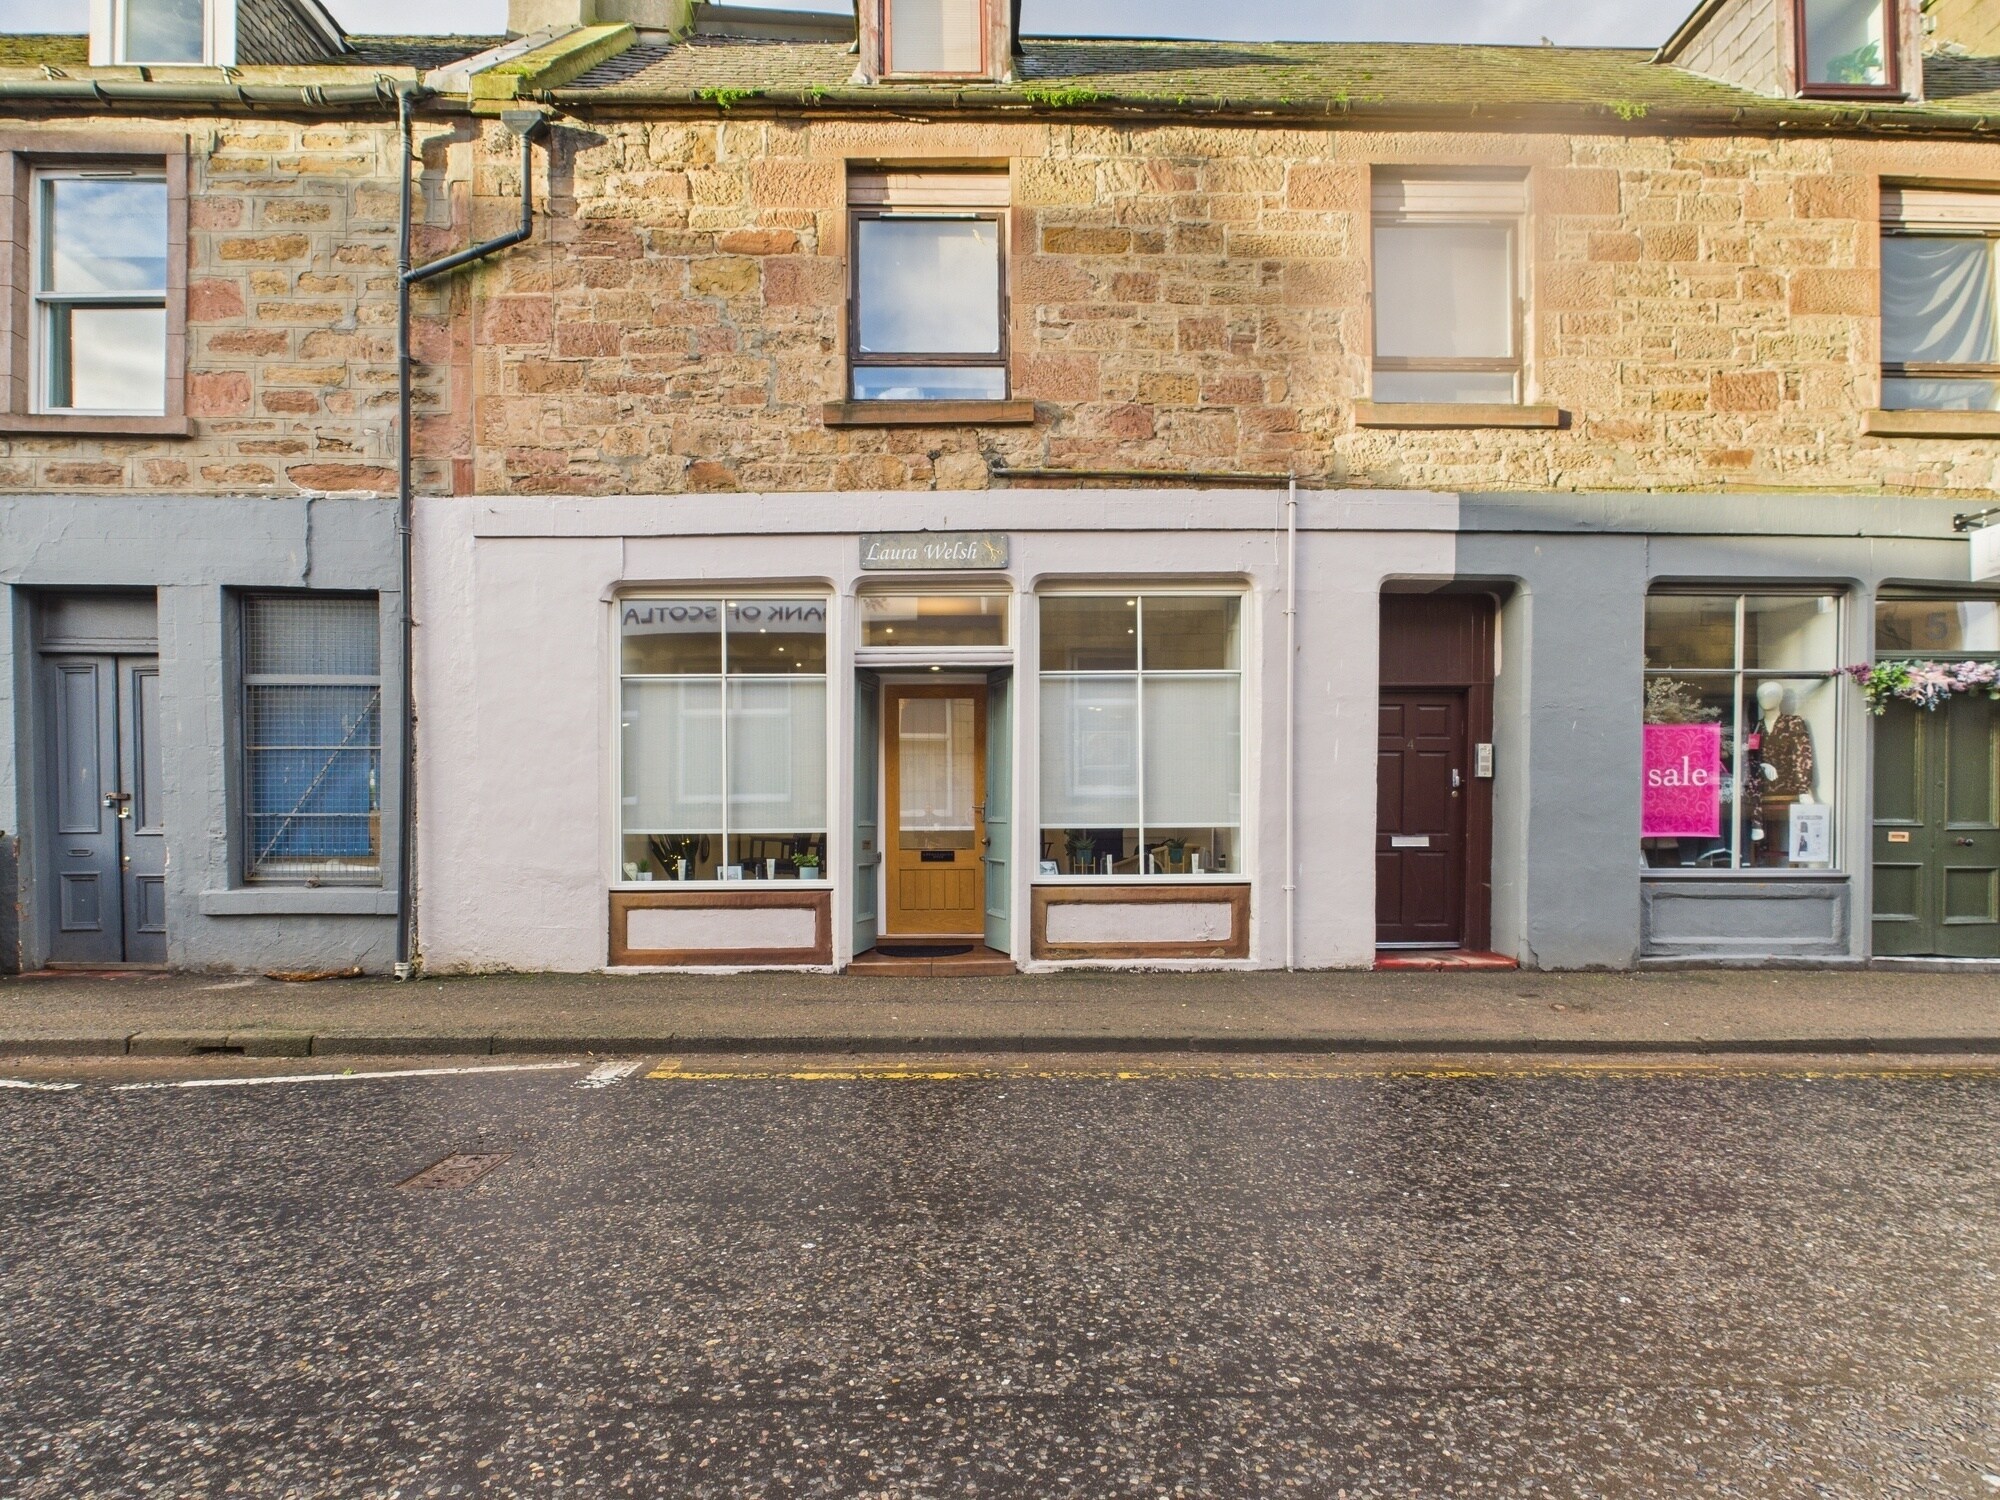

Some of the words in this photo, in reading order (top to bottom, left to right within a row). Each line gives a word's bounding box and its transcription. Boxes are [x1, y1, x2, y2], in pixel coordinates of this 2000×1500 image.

[865, 542, 918, 561] Laura
[923, 541, 977, 560] Welsh
[1926, 611, 1948, 641] 5
[1648, 755, 1709, 787] sale
